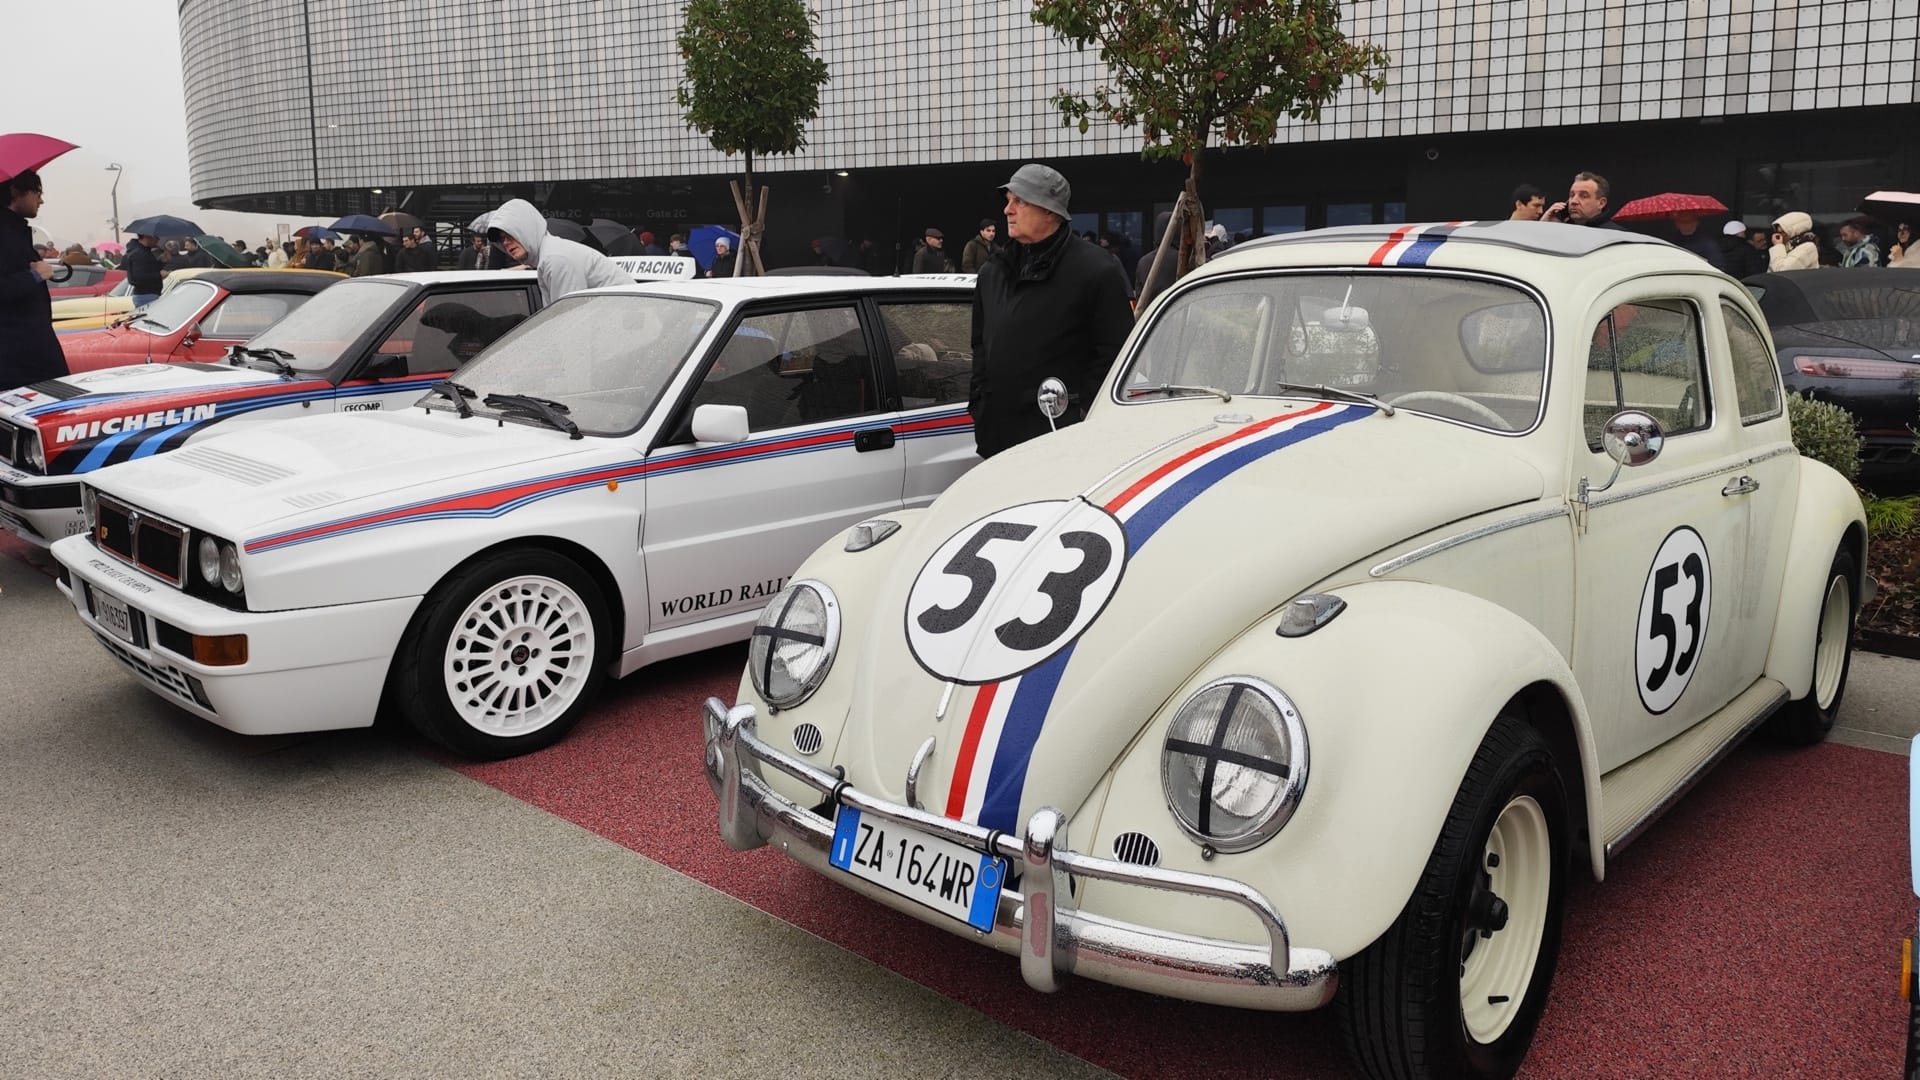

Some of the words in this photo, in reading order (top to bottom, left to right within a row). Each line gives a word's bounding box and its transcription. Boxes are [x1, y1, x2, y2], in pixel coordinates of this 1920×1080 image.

[637, 261, 684, 275] RACING
[56, 403, 217, 443] MICHELIN
[660, 588, 733, 617] WORLD
[739, 575, 793, 602] RALL
[917, 521, 1112, 651] 53
[1646, 552, 1704, 692] 53
[895, 838, 975, 908] 164WR
